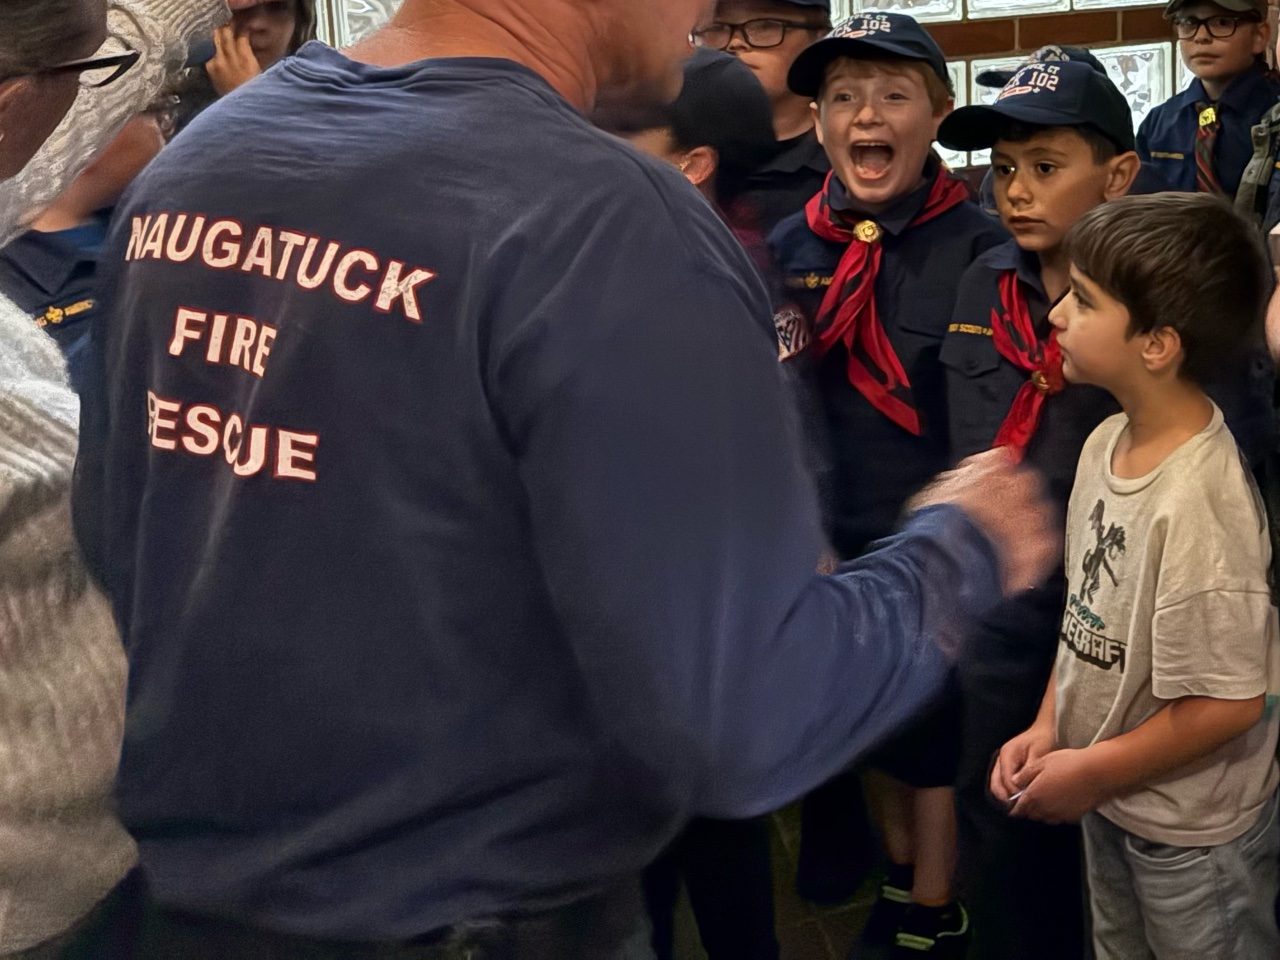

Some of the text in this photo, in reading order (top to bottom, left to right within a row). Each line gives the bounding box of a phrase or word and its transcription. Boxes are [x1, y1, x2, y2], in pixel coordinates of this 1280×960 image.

[861, 20, 891, 33] 102
[1028, 71, 1059, 92] 102
[125, 213, 438, 321] NAUGATUCK
[168, 306, 278, 378] FIRE
